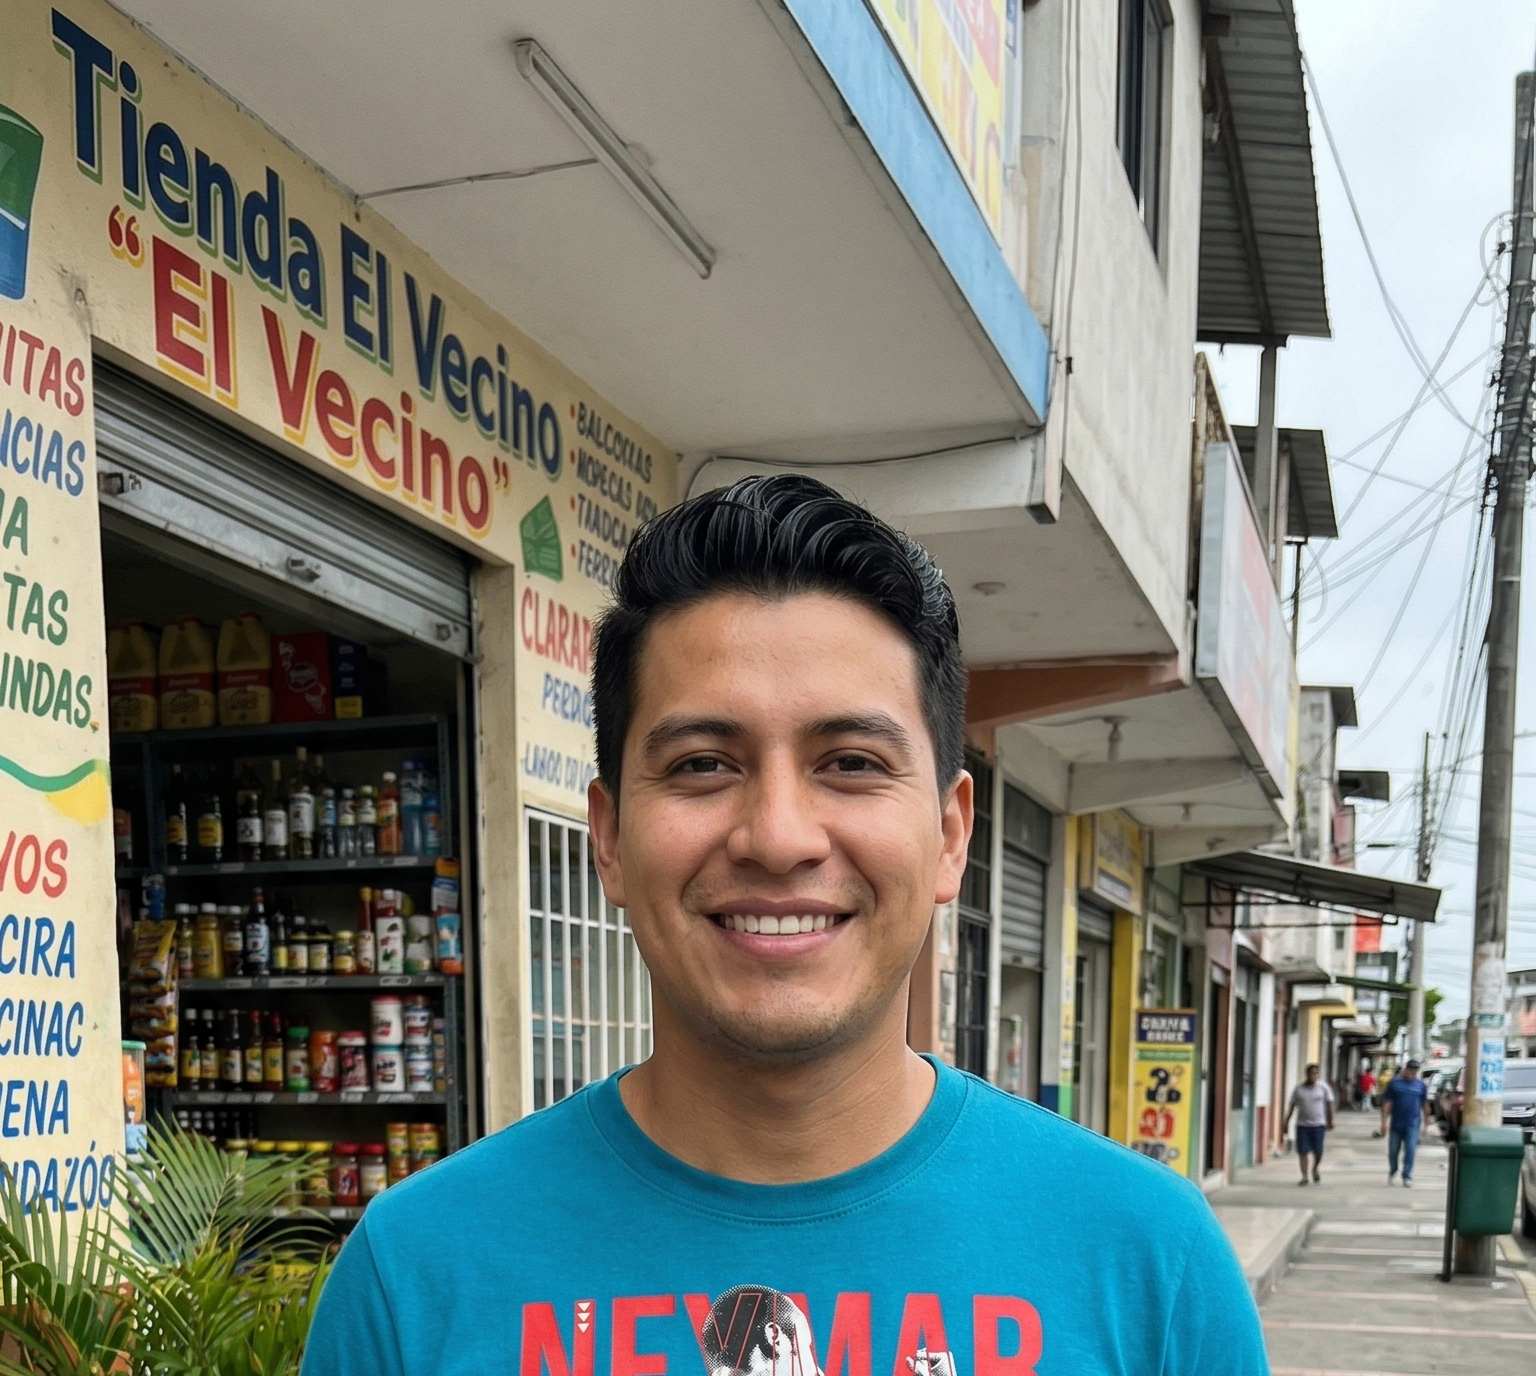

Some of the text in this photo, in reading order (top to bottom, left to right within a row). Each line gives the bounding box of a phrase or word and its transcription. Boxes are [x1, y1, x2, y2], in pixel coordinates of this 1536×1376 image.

[51, 7, 561, 481] Tienda El Vecino
[0, 321, 85, 417] ITAS
[0, 488, 28, 556] A
[0, 914, 75, 979] CIRA
[0, 1079, 69, 1138] ENA
